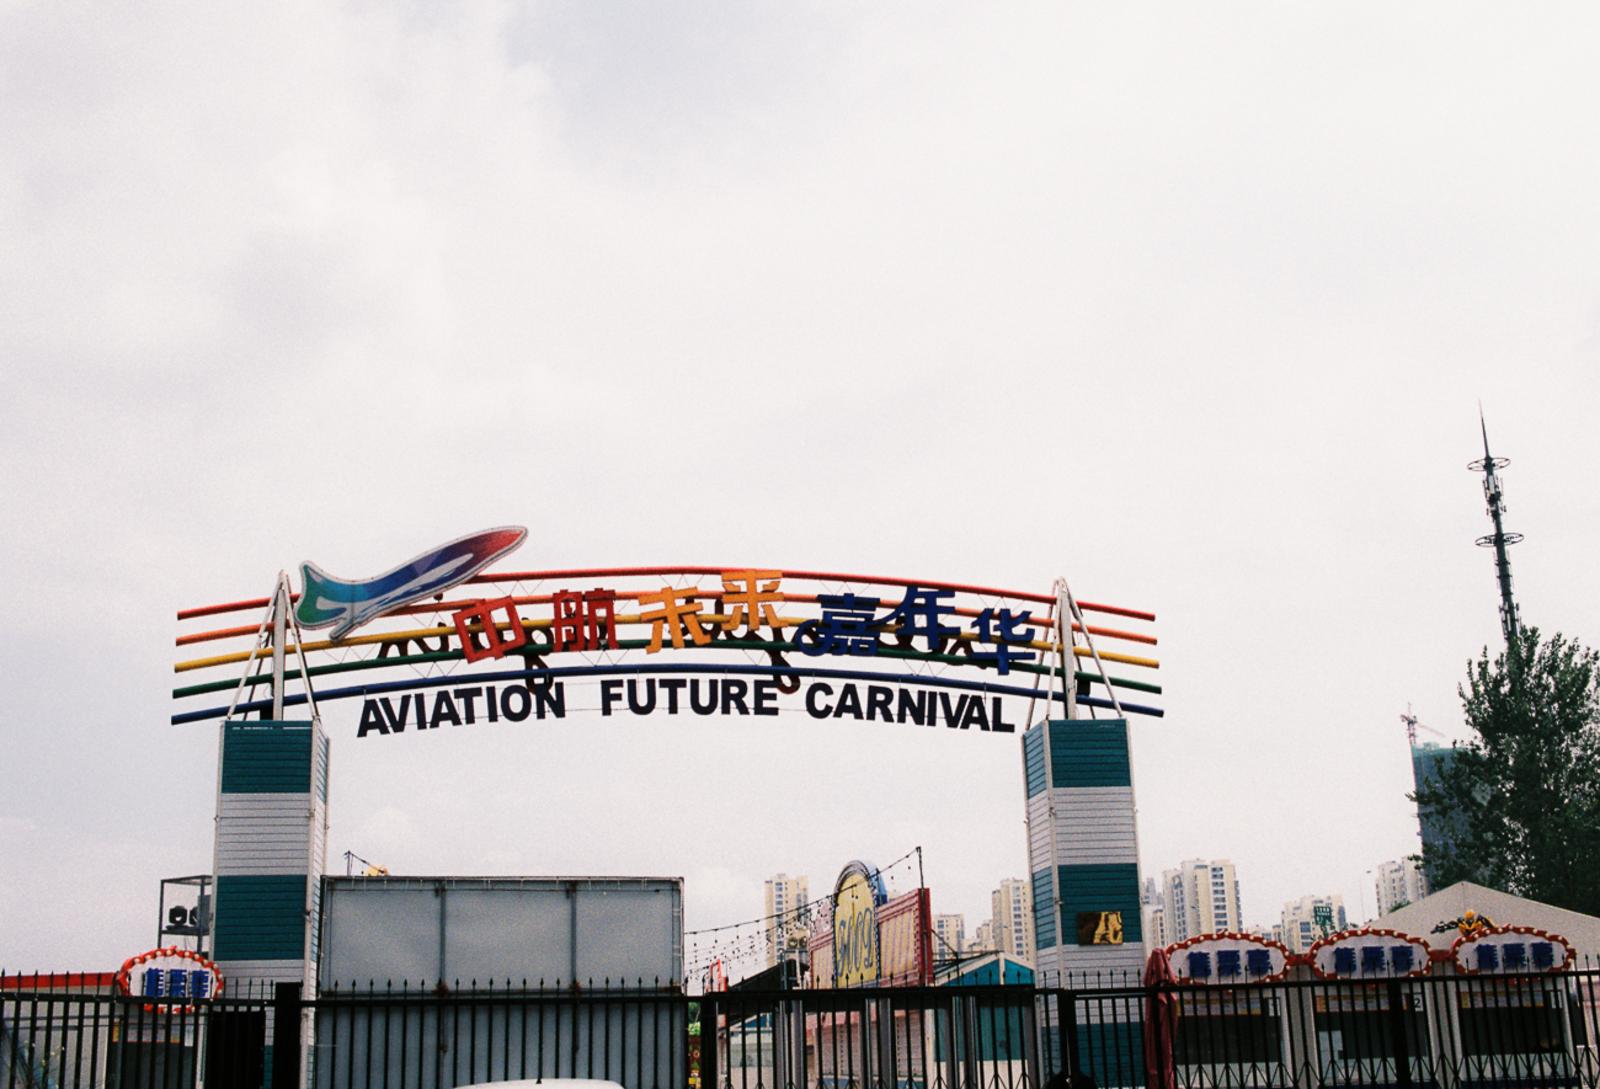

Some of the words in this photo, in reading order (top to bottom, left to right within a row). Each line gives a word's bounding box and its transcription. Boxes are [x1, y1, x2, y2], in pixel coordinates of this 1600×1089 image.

[452, 568, 1037, 677] 中航未来嘉年华
[357, 680, 566, 738] AVIATION
[601, 677, 779, 717] FUTURE
[805, 681, 1016, 734] CARNIVAL
